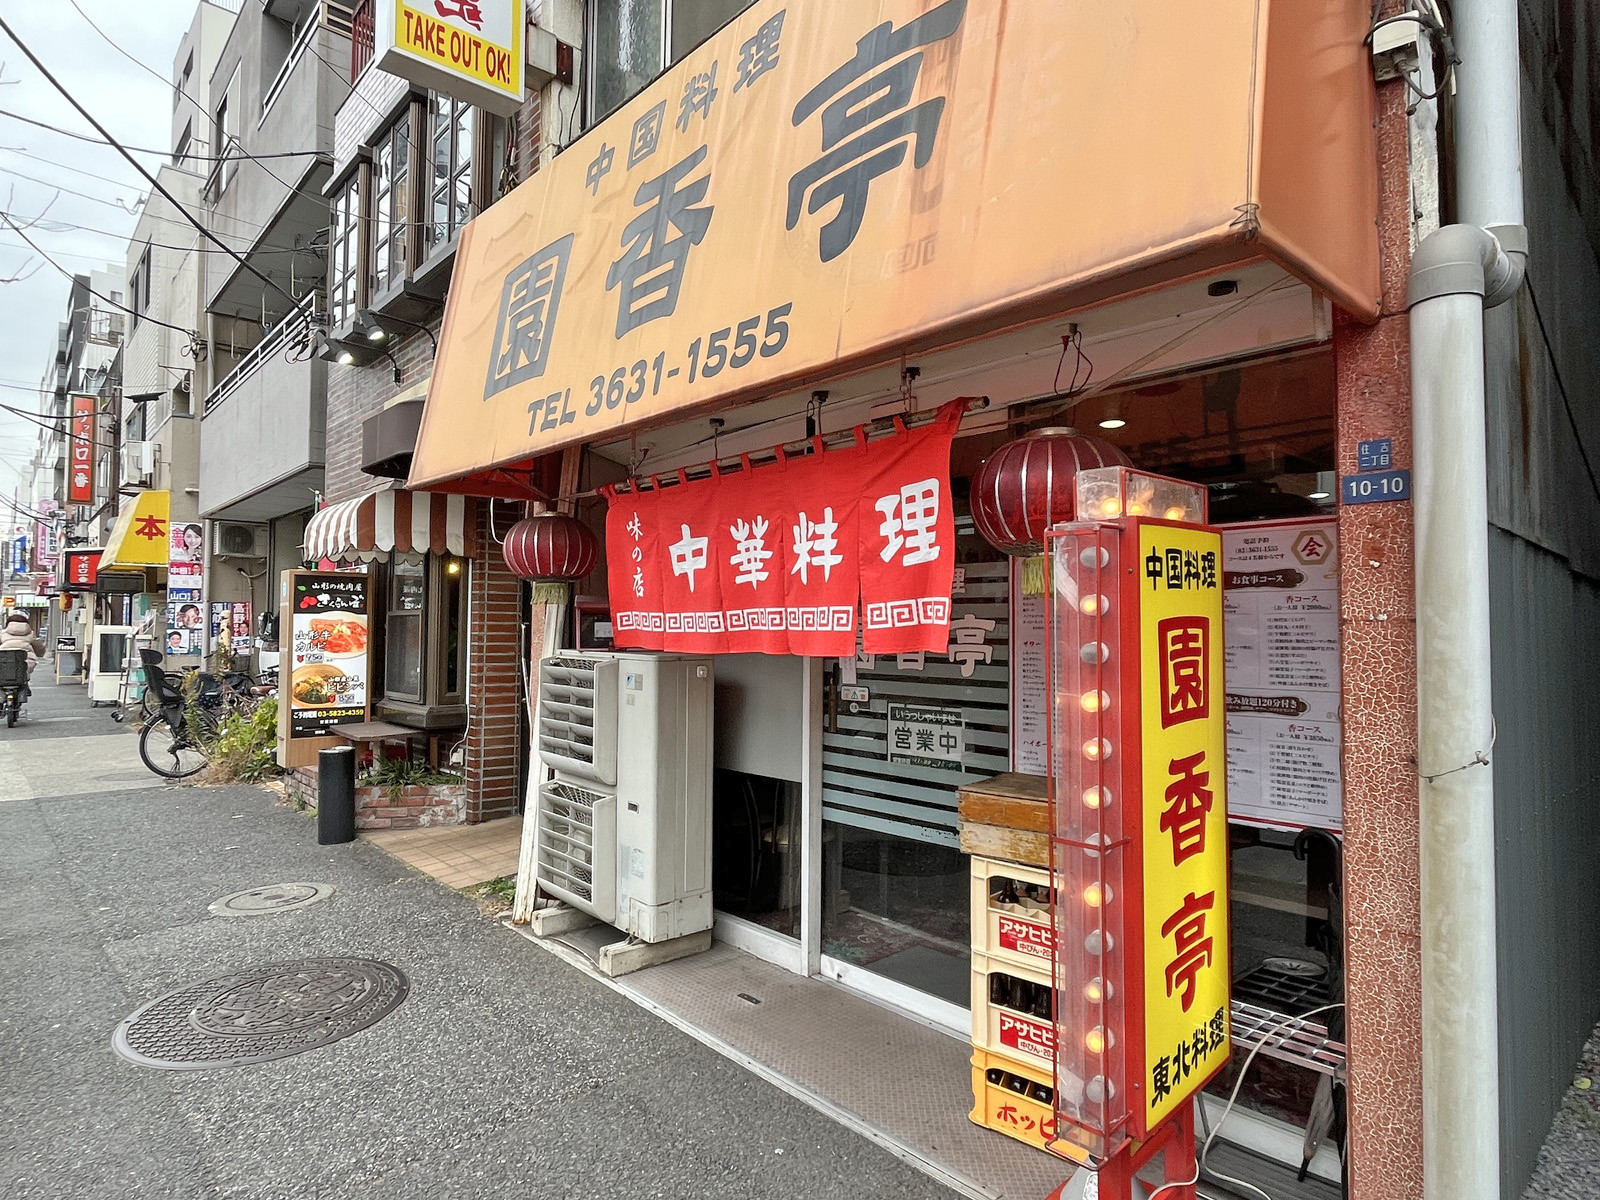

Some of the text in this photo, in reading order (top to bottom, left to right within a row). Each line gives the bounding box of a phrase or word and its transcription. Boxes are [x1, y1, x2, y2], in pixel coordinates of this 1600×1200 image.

[404, 9, 511, 85] TAKE OUT OK!
[586, 9, 786, 197] 中国料理
[483, 0, 966, 403] 園香亭
[527, 302, 794, 437] TEL 3631-1555
[73, 409, 90, 488] サッポロ一番
[1349, 477, 1404, 497] 10-10
[135, 514, 167, 541] 本
[625, 512, 645, 598] 味の店
[668, 477, 941, 593] 中華料理
[1144, 544, 1218, 592] 中国料理
[894, 725, 958, 755] 営業中
[1158, 615, 1215, 1015] 園香亭
[1150, 1006, 1226, 1110] 東北料理
